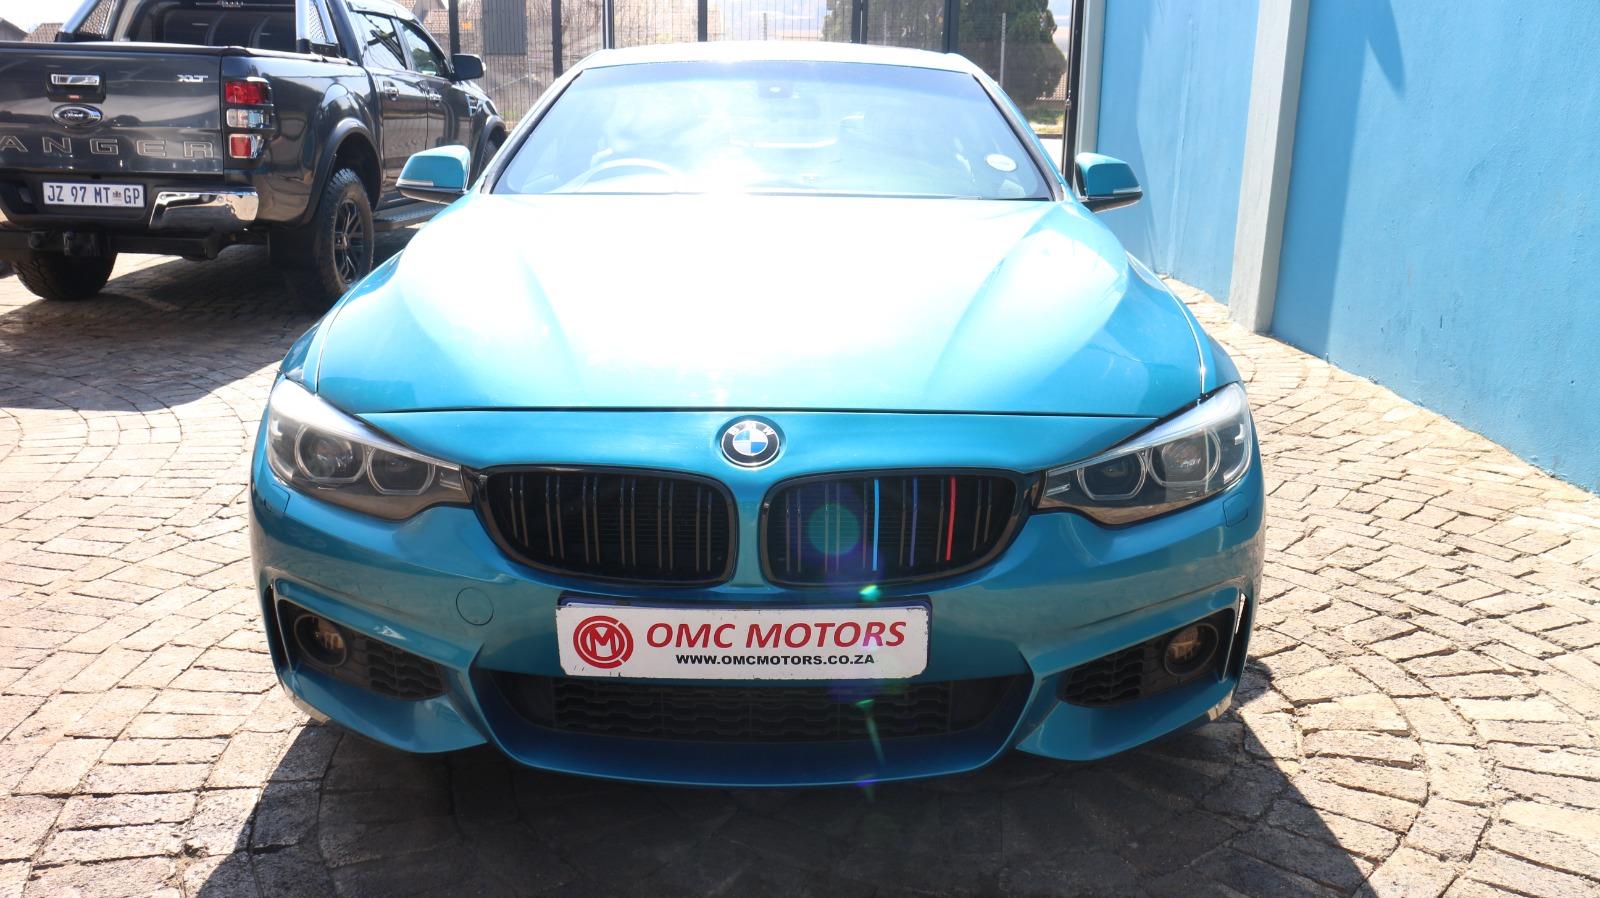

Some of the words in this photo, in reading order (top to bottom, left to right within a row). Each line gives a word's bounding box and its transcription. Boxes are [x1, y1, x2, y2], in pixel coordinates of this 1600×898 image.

[176, 74, 209, 83] XLT
[48, 185, 65, 202] JZ
[71, 186, 87, 203] 97
[94, 187, 111, 204] MT
[123, 187, 140, 205] GP
[646, 622, 736, 649] OMC
[745, 621, 907, 649] MOTORS
[675, 654, 875, 665] WWW.OMCMOTORS.CO.ZA
